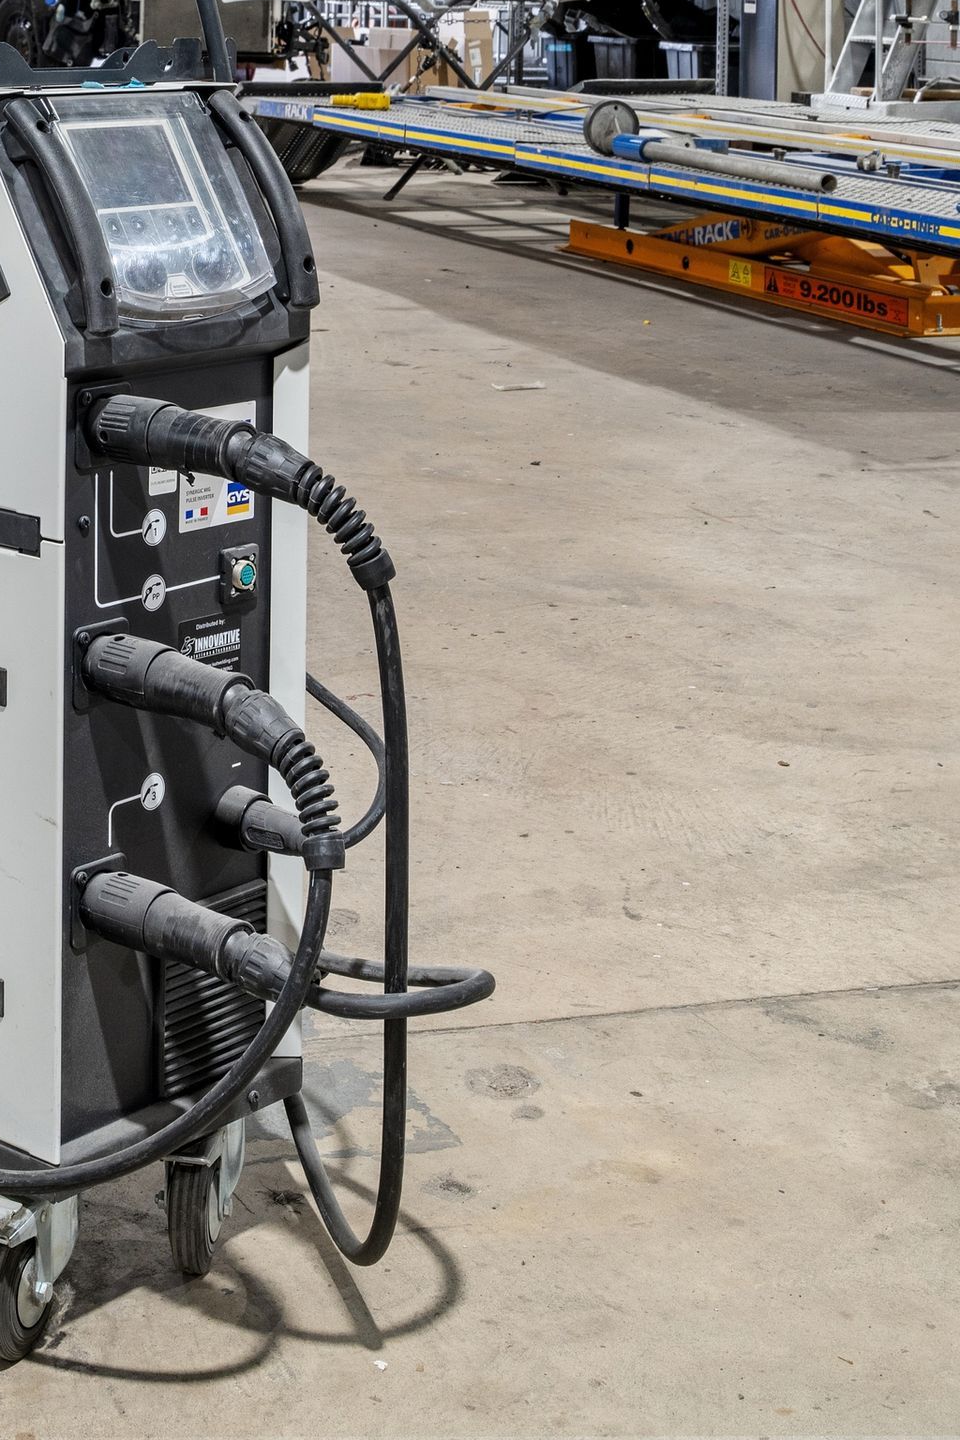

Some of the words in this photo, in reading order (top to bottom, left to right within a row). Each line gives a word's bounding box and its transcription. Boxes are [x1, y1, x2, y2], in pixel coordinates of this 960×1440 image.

[285, 102, 309, 120] RACK
[694, 220, 733, 246] RACK
[186, 488, 203, 497] SYNERGIC
[227, 488, 251, 504] GYS
[186, 495, 199, 504] PULSE
[199, 493, 215, 502] INVERTER
[152, 593, 161, 601] PP
[195, 620, 219, 631] Distributed
[194, 628, 240, 653] INNOVATIVE
[151, 791, 157, 801] 3
